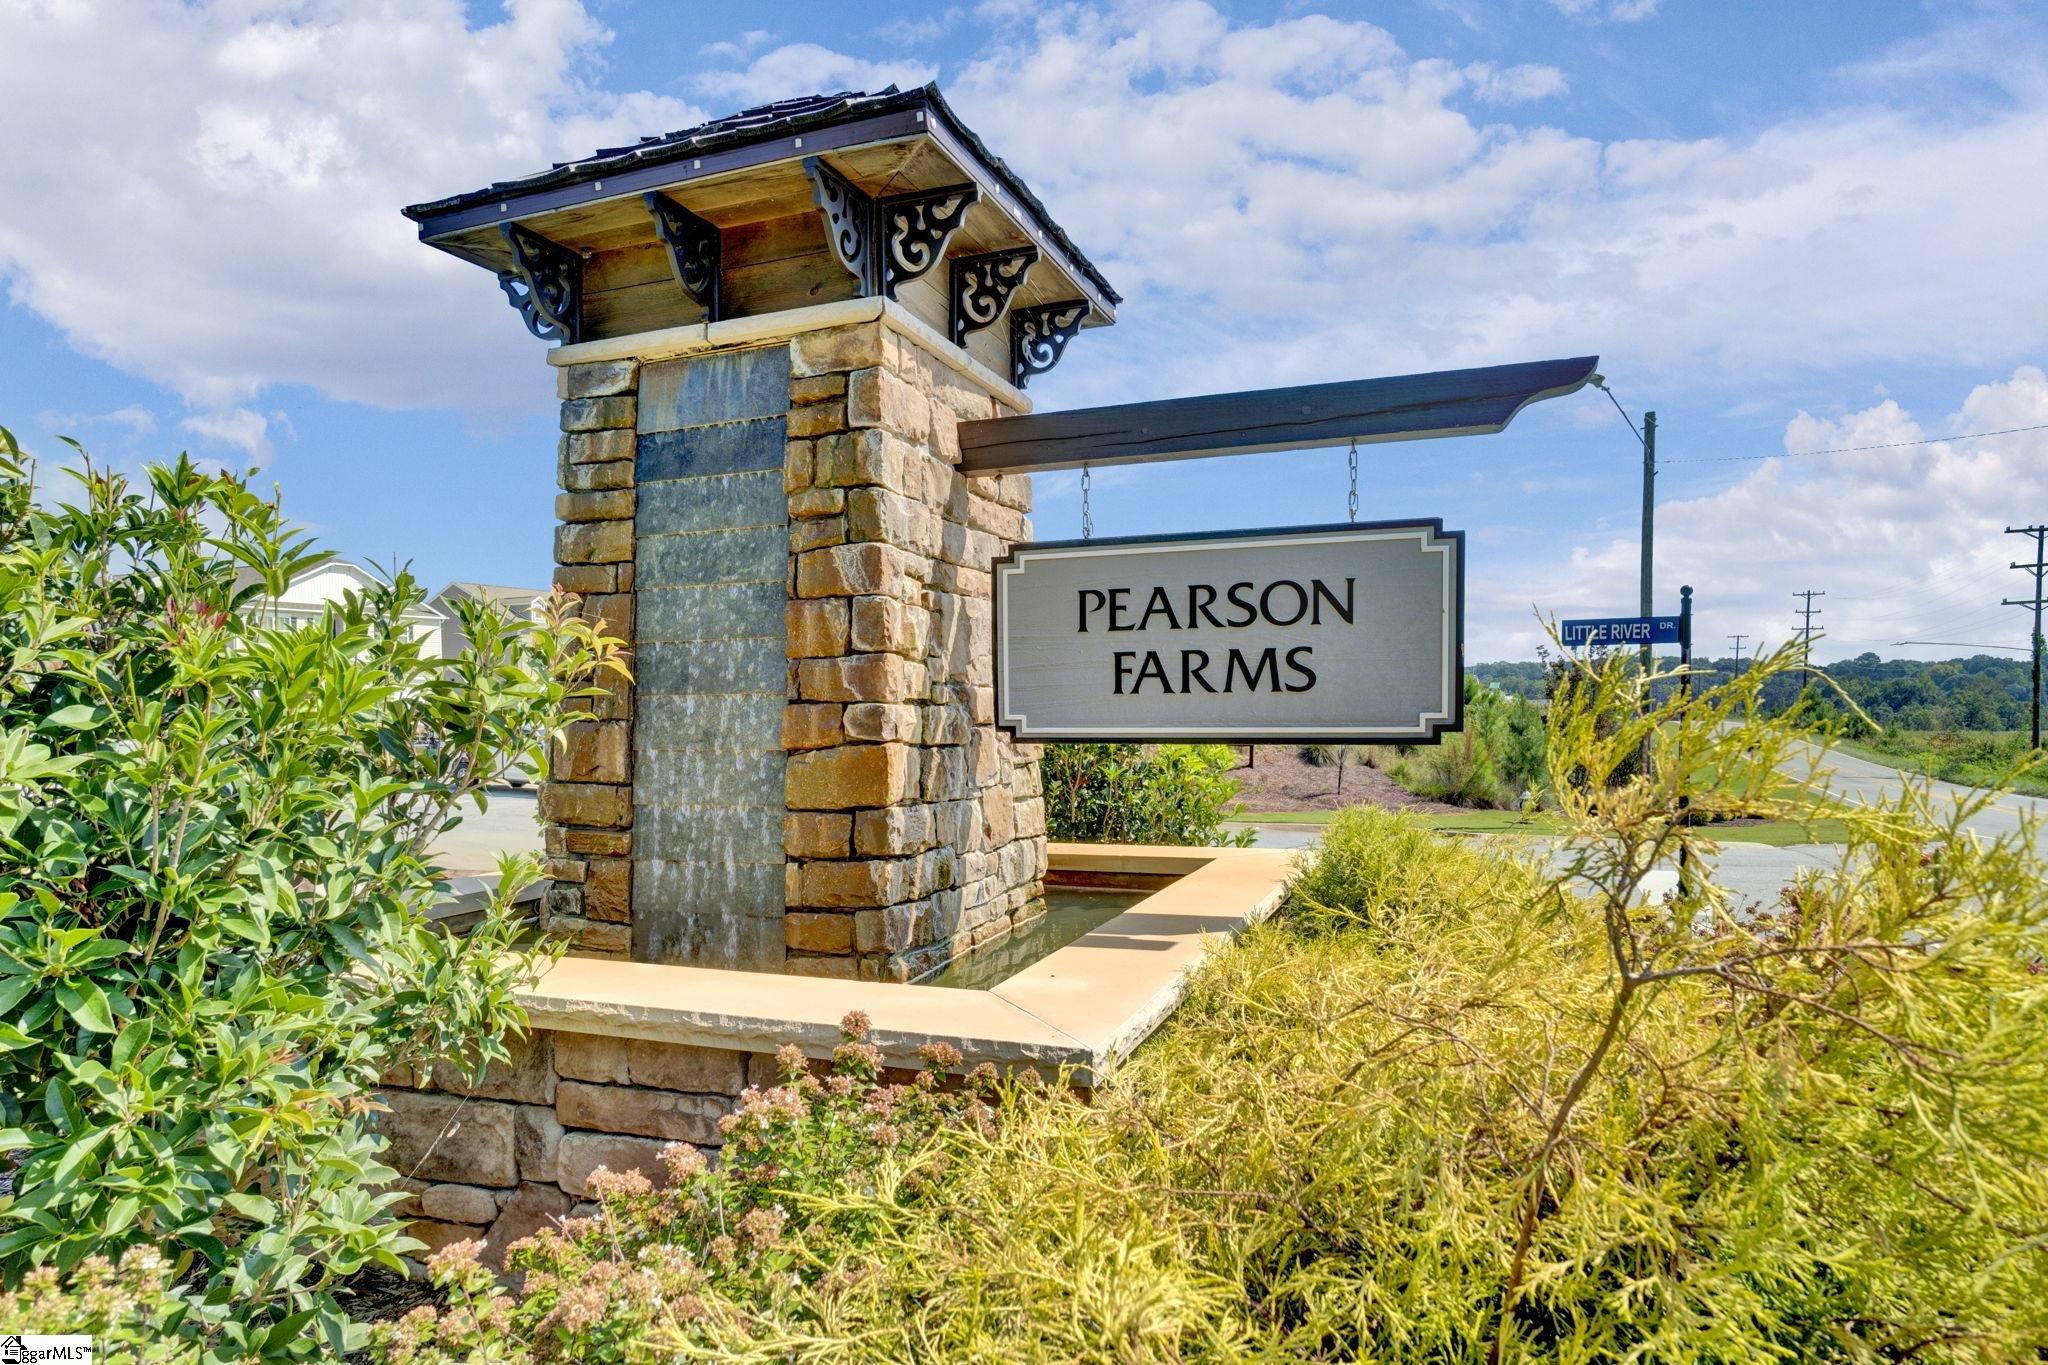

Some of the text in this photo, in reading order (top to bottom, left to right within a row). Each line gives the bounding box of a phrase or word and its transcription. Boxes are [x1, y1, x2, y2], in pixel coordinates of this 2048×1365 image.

[1077, 577, 1356, 633] PEARSON
[1611, 623, 1650, 639] RIVER
[1112, 646, 1317, 695] FARMS
